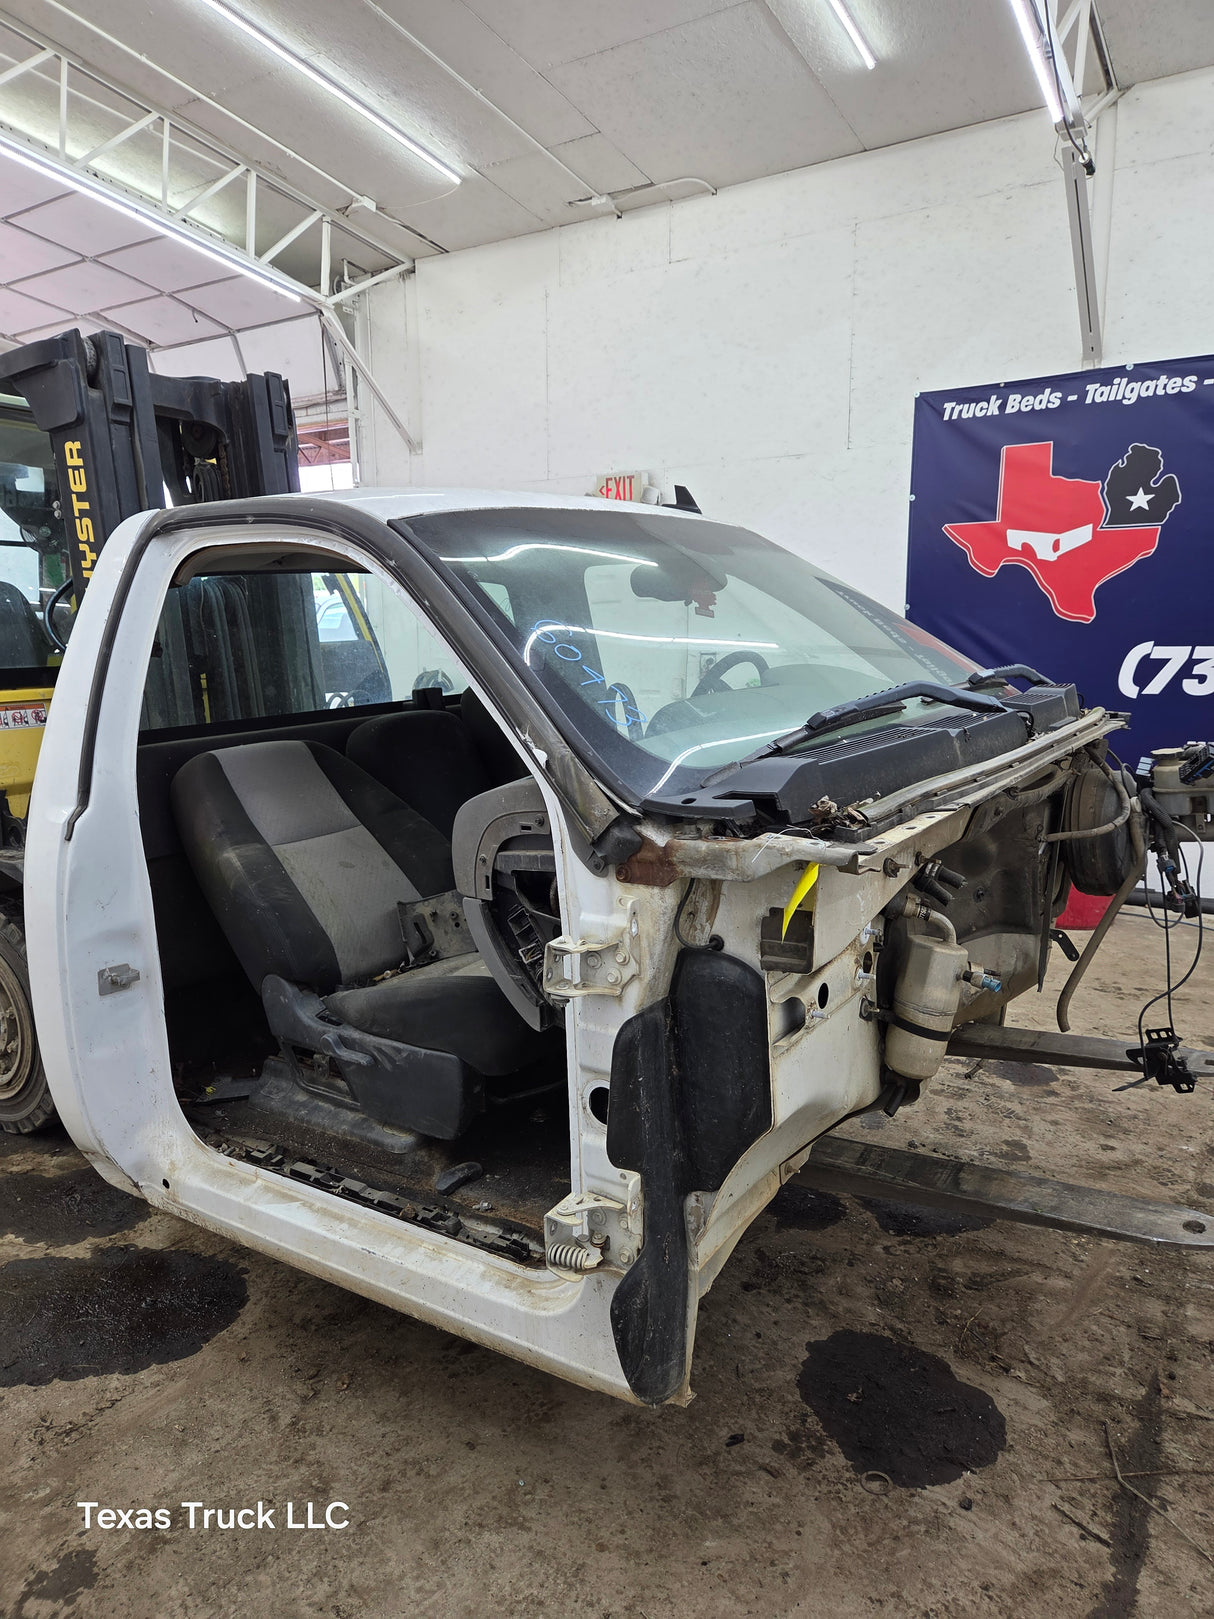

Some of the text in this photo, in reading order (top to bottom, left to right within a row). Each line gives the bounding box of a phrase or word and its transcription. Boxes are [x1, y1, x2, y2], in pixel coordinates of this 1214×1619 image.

[943, 395, 1002, 421] Truck
[1005, 388, 1062, 414] Beds
[1085, 375, 1198, 405] Tailgates
[605, 475, 635, 501] EXIT
[1118, 640, 1214, 699] (73
